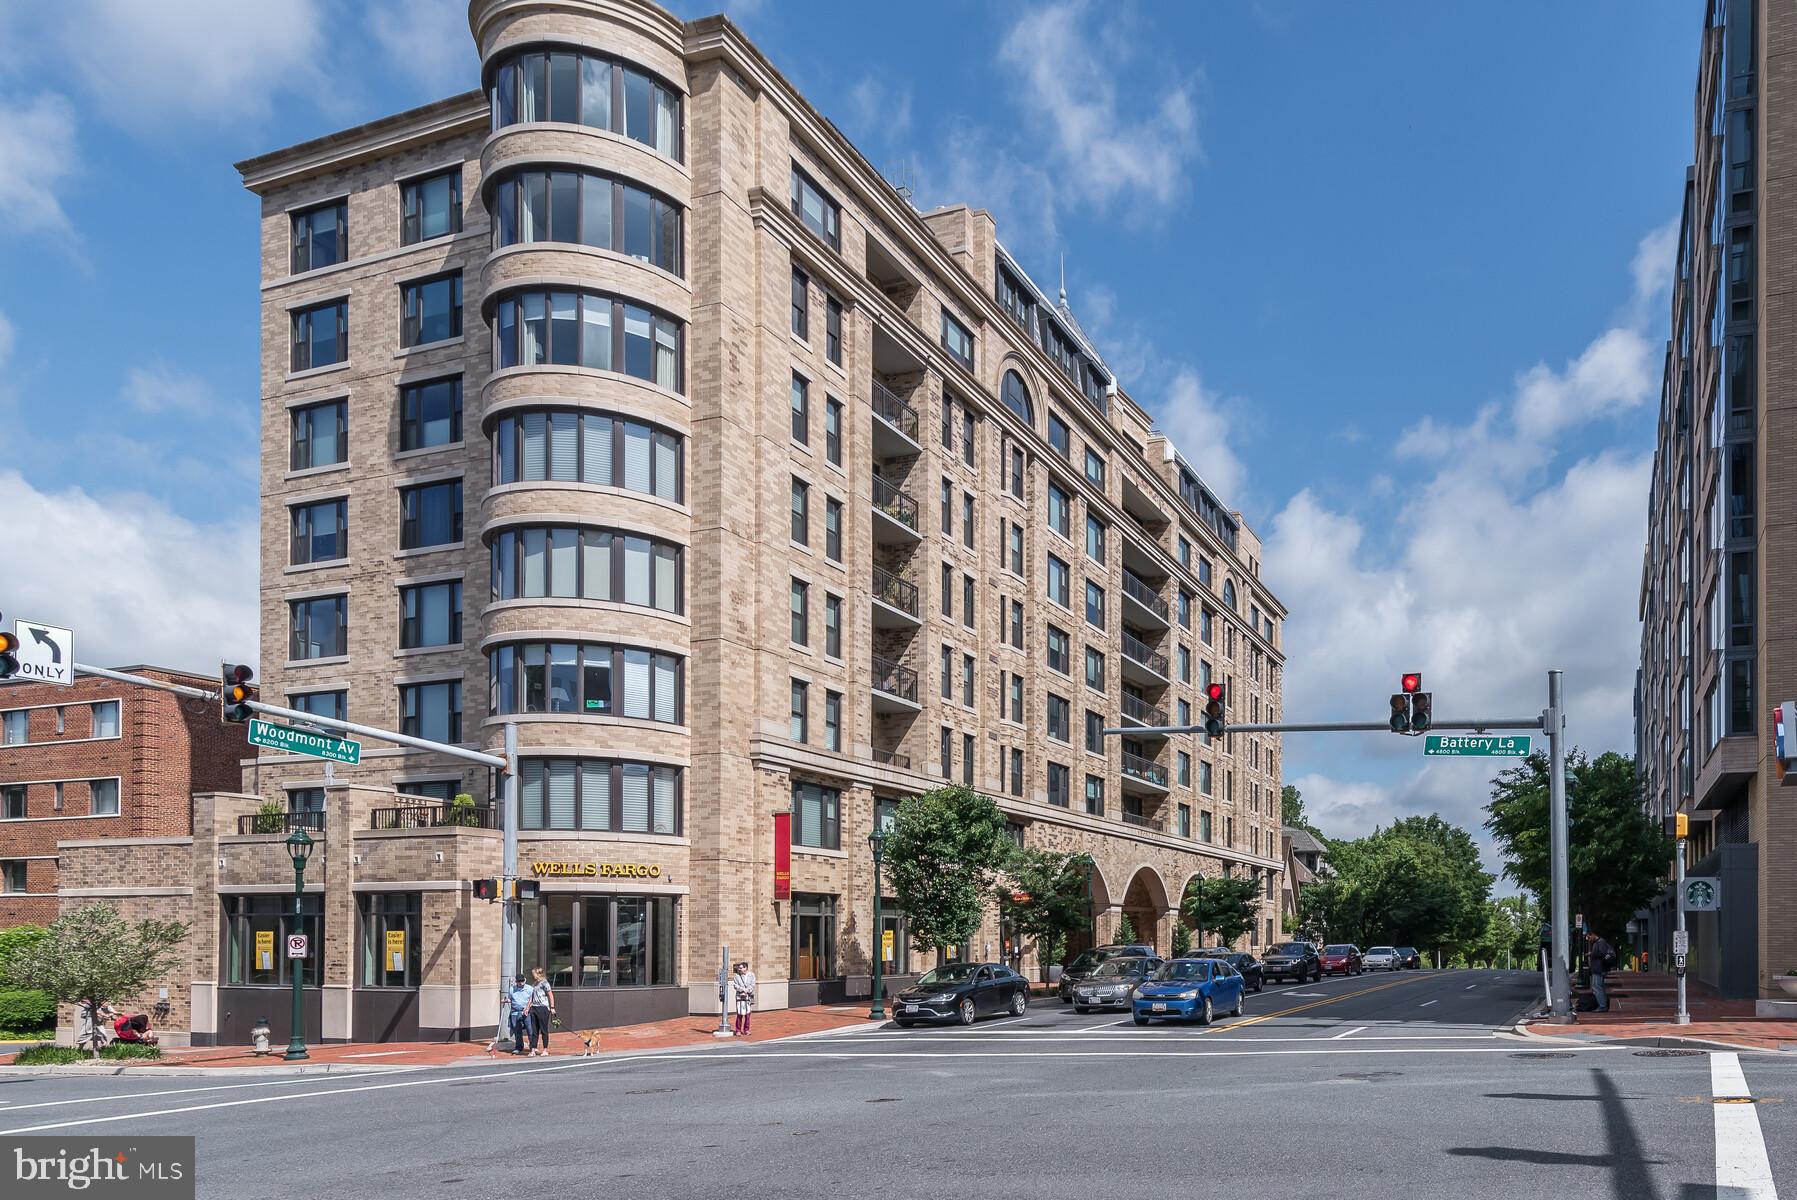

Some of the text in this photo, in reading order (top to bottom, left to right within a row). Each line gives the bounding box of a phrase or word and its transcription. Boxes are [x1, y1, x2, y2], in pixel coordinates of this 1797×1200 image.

[22, 662, 65, 679] ONLY
[257, 723, 354, 754] Woodmont Av
[262, 738, 279, 746] 8200
[1440, 737, 1515, 750] Battery La
[530, 862, 661, 879] WELLS FARGO
